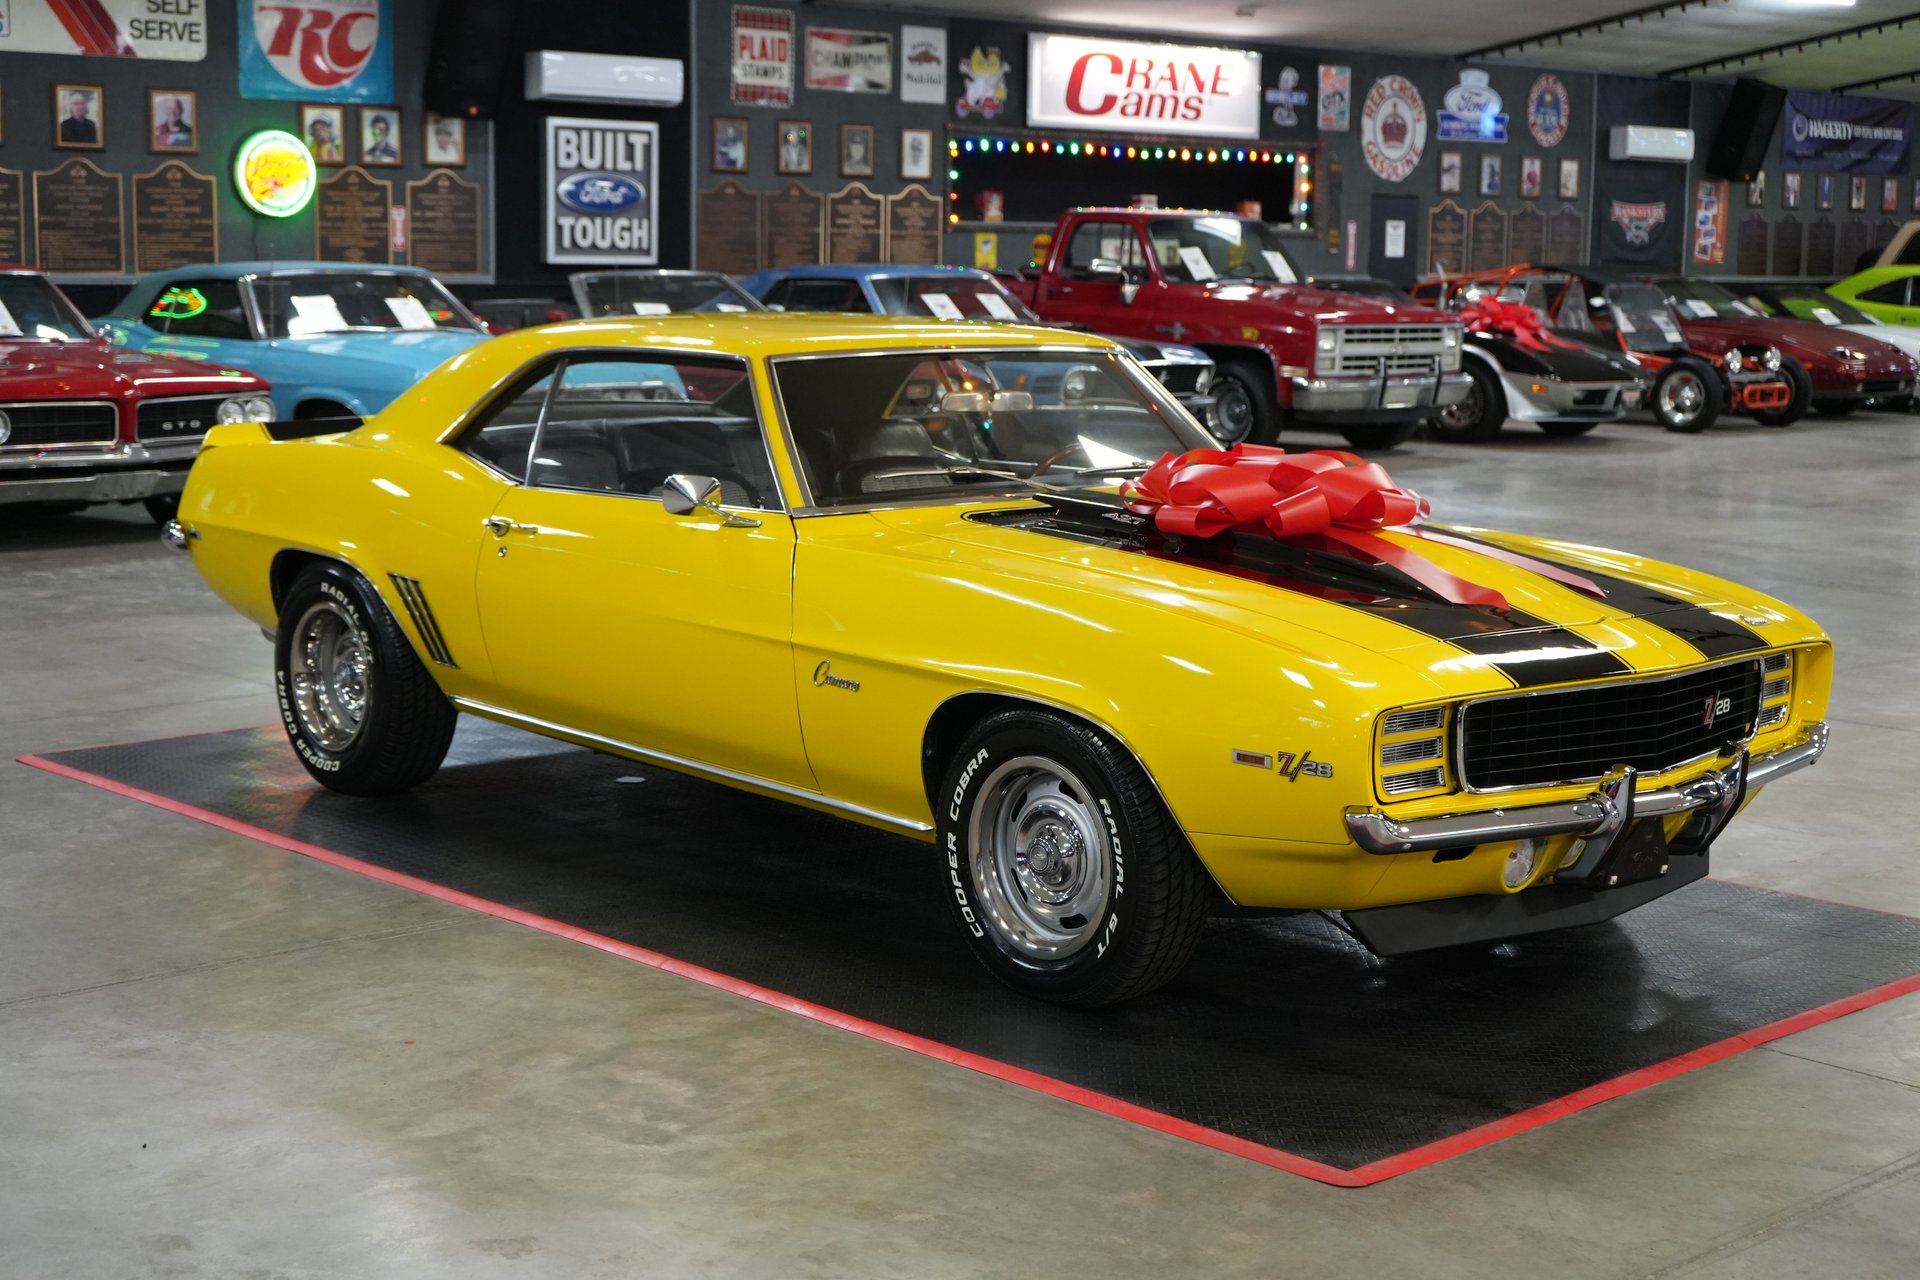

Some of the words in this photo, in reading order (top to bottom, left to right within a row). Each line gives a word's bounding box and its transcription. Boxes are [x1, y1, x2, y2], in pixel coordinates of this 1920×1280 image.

[146, 0, 200, 15] SELF
[129, 18, 201, 43] SERVE
[258, 6, 376, 86] RC
[738, 34, 787, 63] PLAID
[741, 63, 785, 80] STAMPS
[1066, 53, 1232, 116] CRANE
[1365, 82, 1386, 119] RED
[1808, 119, 1853, 140] HAGERTY
[557, 128, 650, 172] BUILT
[1366, 141, 1421, 179] GASOLINE
[580, 180, 630, 204] Ford
[557, 216, 649, 249] TOUGH
[162, 419, 201, 431] GTO
[320, 582, 360, 626] RADIAL
[813, 659, 860, 692] Camaro
[277, 670, 298, 735] COBRA
[1702, 689, 1731, 730] Z/28
[296, 738, 340, 771] COOPER
[1277, 750, 1334, 783] Z/28
[949, 748, 989, 822] COBRA
[1099, 798, 1124, 900] RADIAL
[947, 831, 985, 938] COOPER
[1097, 912, 1119, 959] G/T
